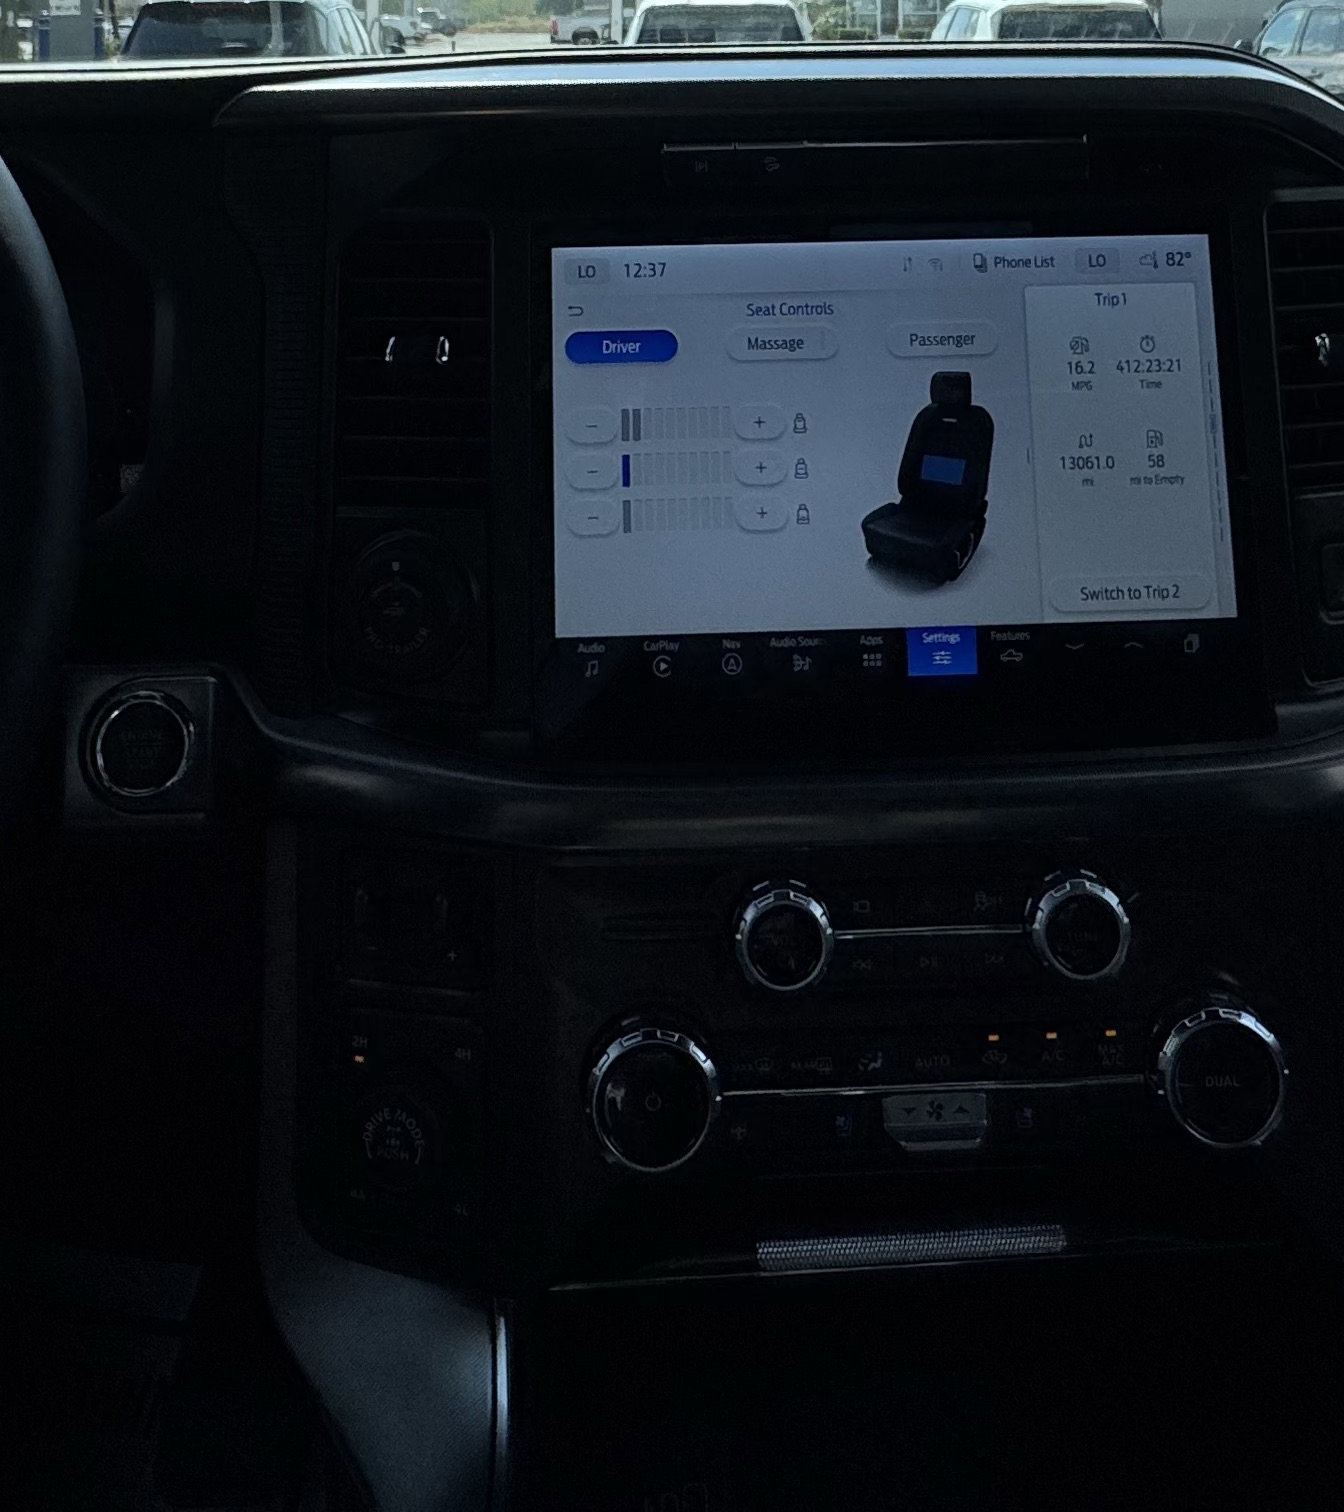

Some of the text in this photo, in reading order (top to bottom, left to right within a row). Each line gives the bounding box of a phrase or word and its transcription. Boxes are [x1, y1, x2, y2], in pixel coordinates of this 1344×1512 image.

[993, 254, 1056, 269] Phone List
[1088, 254, 1106, 268] LO
[1165, 251, 1192, 267] 82°
[578, 263, 667, 279] LO 12:37
[1093, 292, 1120, 309] Trip
[746, 302, 835, 317] Seat Controls
[602, 340, 642, 354] Driver
[746, 337, 805, 352] Massage
[909, 332, 976, 348] Passenger
[1066, 360, 1096, 376] 16.2
[1115, 359, 1182, 374] 412:23:21
[1070, 379, 1094, 391] MPG
[1139, 379, 1163, 390] Time
[1059, 455, 1115, 471] 13061.0
[1147, 455, 1165, 469] 58
[1080, 584, 1180, 602] Switch to Trip 2
[642, 639, 680, 653] CarPlay
[721, 638, 742, 649] Nav
[769, 637, 797, 648] Audio
[859, 634, 885, 647] Apps
[921, 632, 962, 646] Settings
[576, 642, 606, 654] Audio
[351, 1034, 369, 1049] 2H
[914, 1054, 951, 1069] AUTO
[1204, 1074, 1251, 1089] DUAL
